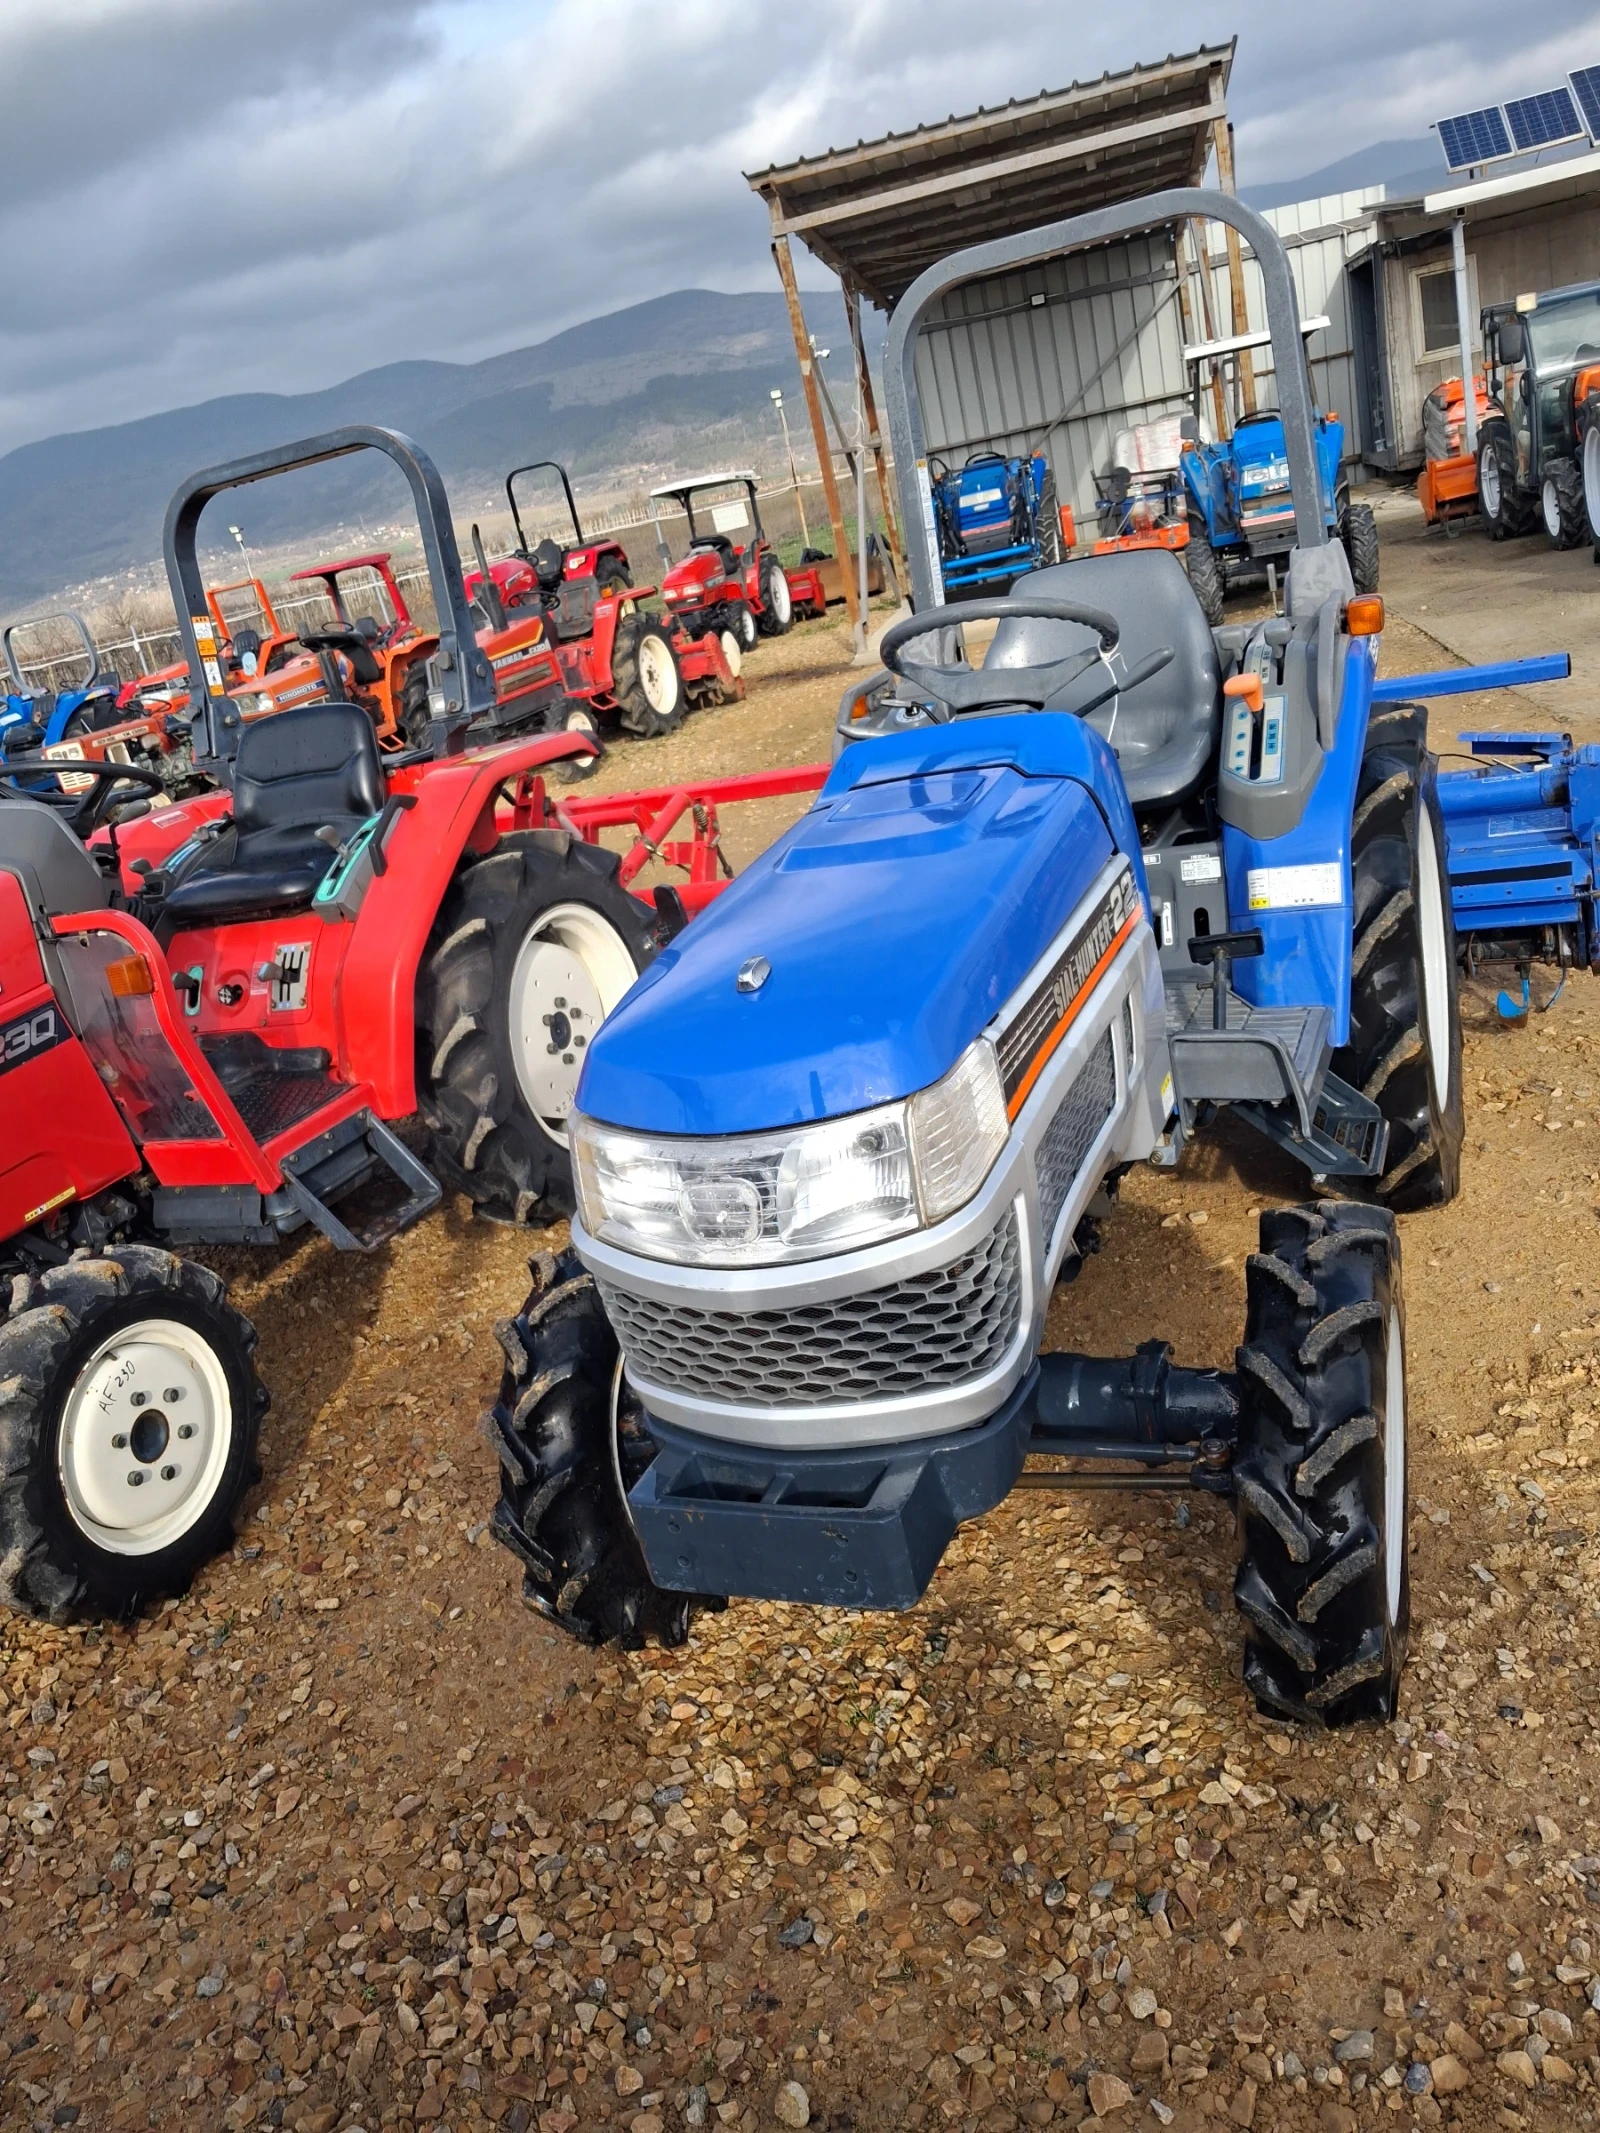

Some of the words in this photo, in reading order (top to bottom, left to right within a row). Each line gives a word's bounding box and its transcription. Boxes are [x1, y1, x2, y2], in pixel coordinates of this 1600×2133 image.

[491, 651, 524, 670] YANMAR
[279, 683, 318, 702] HINOMOTO
[114, 1360, 136, 1388] 230
